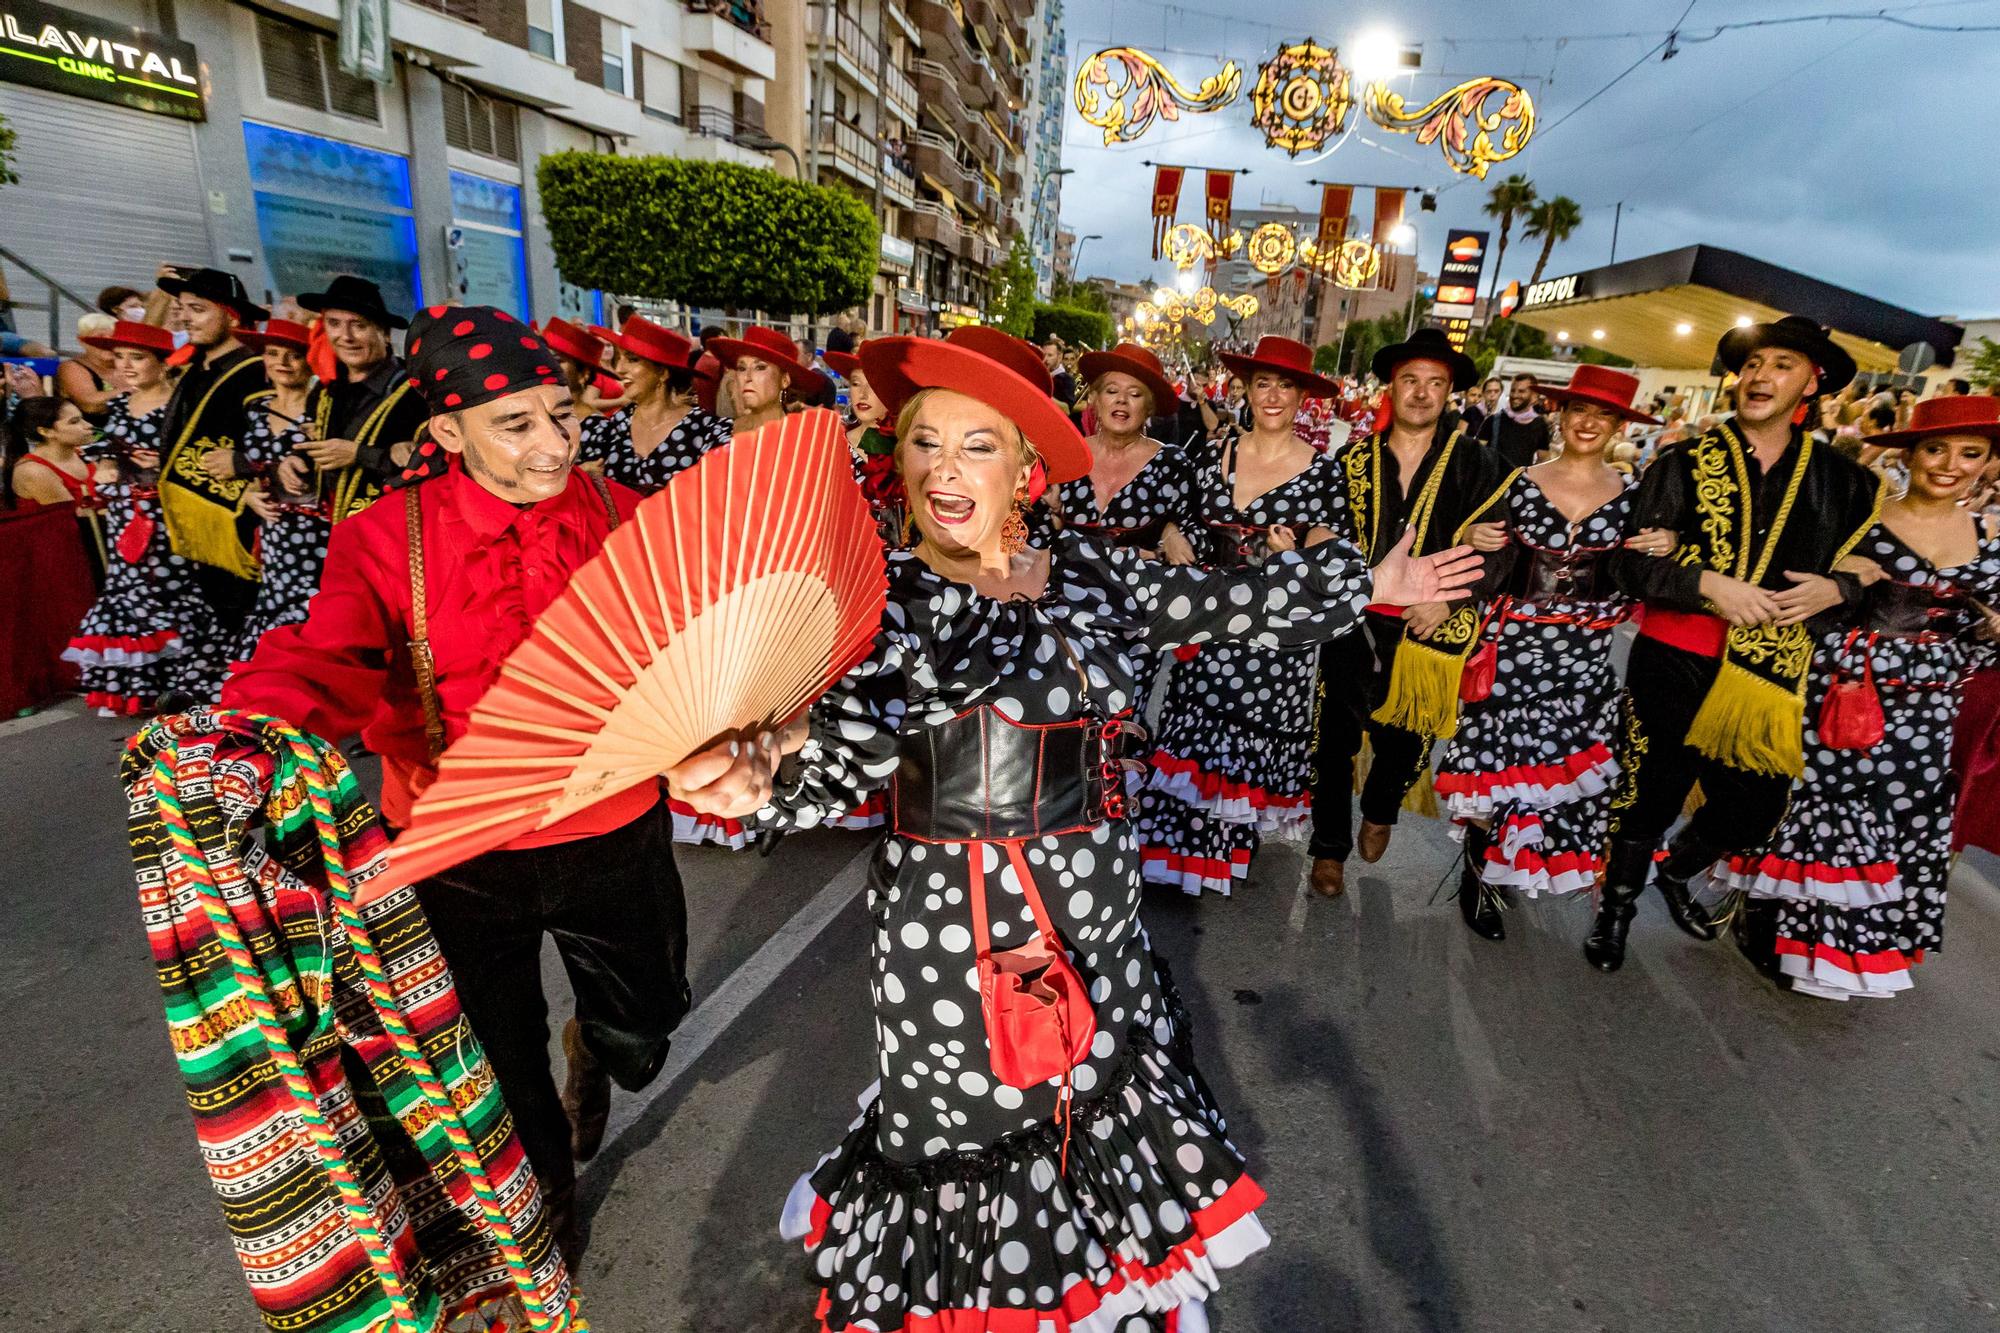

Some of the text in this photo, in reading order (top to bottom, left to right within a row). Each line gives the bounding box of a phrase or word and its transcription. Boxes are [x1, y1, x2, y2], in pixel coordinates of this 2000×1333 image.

[57, 56, 116, 83] CLINIC
[1444, 263, 1479, 273] REPSOL
[1525, 275, 1578, 306] REPSOL
